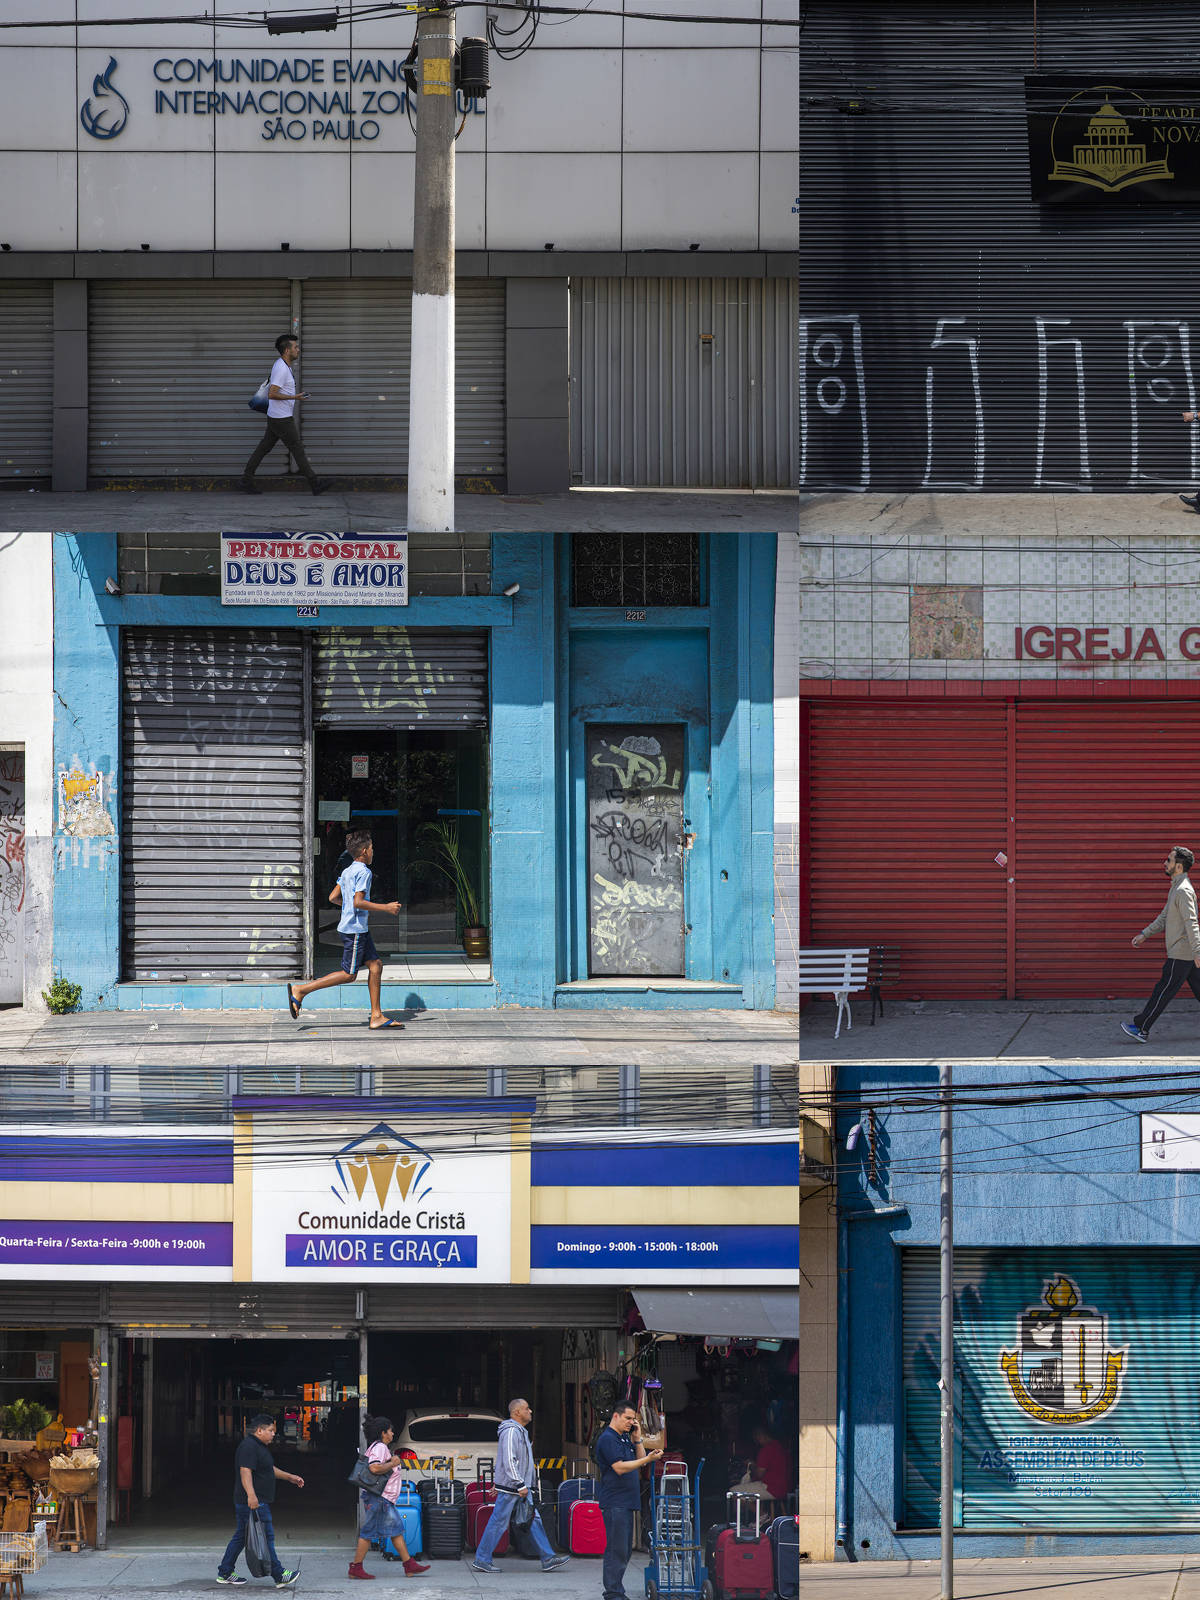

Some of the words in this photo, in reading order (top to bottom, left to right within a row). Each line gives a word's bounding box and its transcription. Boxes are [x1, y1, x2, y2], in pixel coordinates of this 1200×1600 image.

[153, 58, 325, 84] COMUNIDADE
[155, 90, 351, 115] INTERNACIONAL
[362, 90, 417, 115] ZON
[456, 91, 486, 115] UL
[261, 117, 306, 141] SÃO
[313, 119, 380, 141] PAULO
[227, 541, 402, 561] PENTECOSTAL
[224, 561, 298, 587] DEUS
[304, 562, 324, 587] É
[331, 562, 405, 588] AMOR
[298, 606, 317, 616] 2214
[626, 611, 645, 620] 2212
[1014, 626, 1166, 661] IGREJA
[298, 1209, 412, 1230] Comunidade
[416, 1212, 466, 1230] Cristã
[0, 1236, 63, 1248] Quarta-Feira
[71, 1237, 128, 1248] Sexta-Feira
[163, 1241, 170, 1249] e
[172, 1239, 206, 1250] 19:00h
[557, 1241, 601, 1254] Domingo
[608, 1242, 637, 1252] 9:00h
[644, 1242, 677, 1252] 15:00h
[685, 1242, 719, 1252] 18:00h
[303, 1239, 367, 1261] AMOR
[373, 1243, 384, 1261] E
[389, 1240, 462, 1268] GRAÇA
[1008, 1436, 1048, 1447] IGREJA
[1052, 1434, 1123, 1447] EVANGÉLICA
[979, 1448, 1077, 1468] ASSEMBLÉIA
[1081, 1450, 1101, 1468] DE
[1103, 1450, 1145, 1468] DEUS
